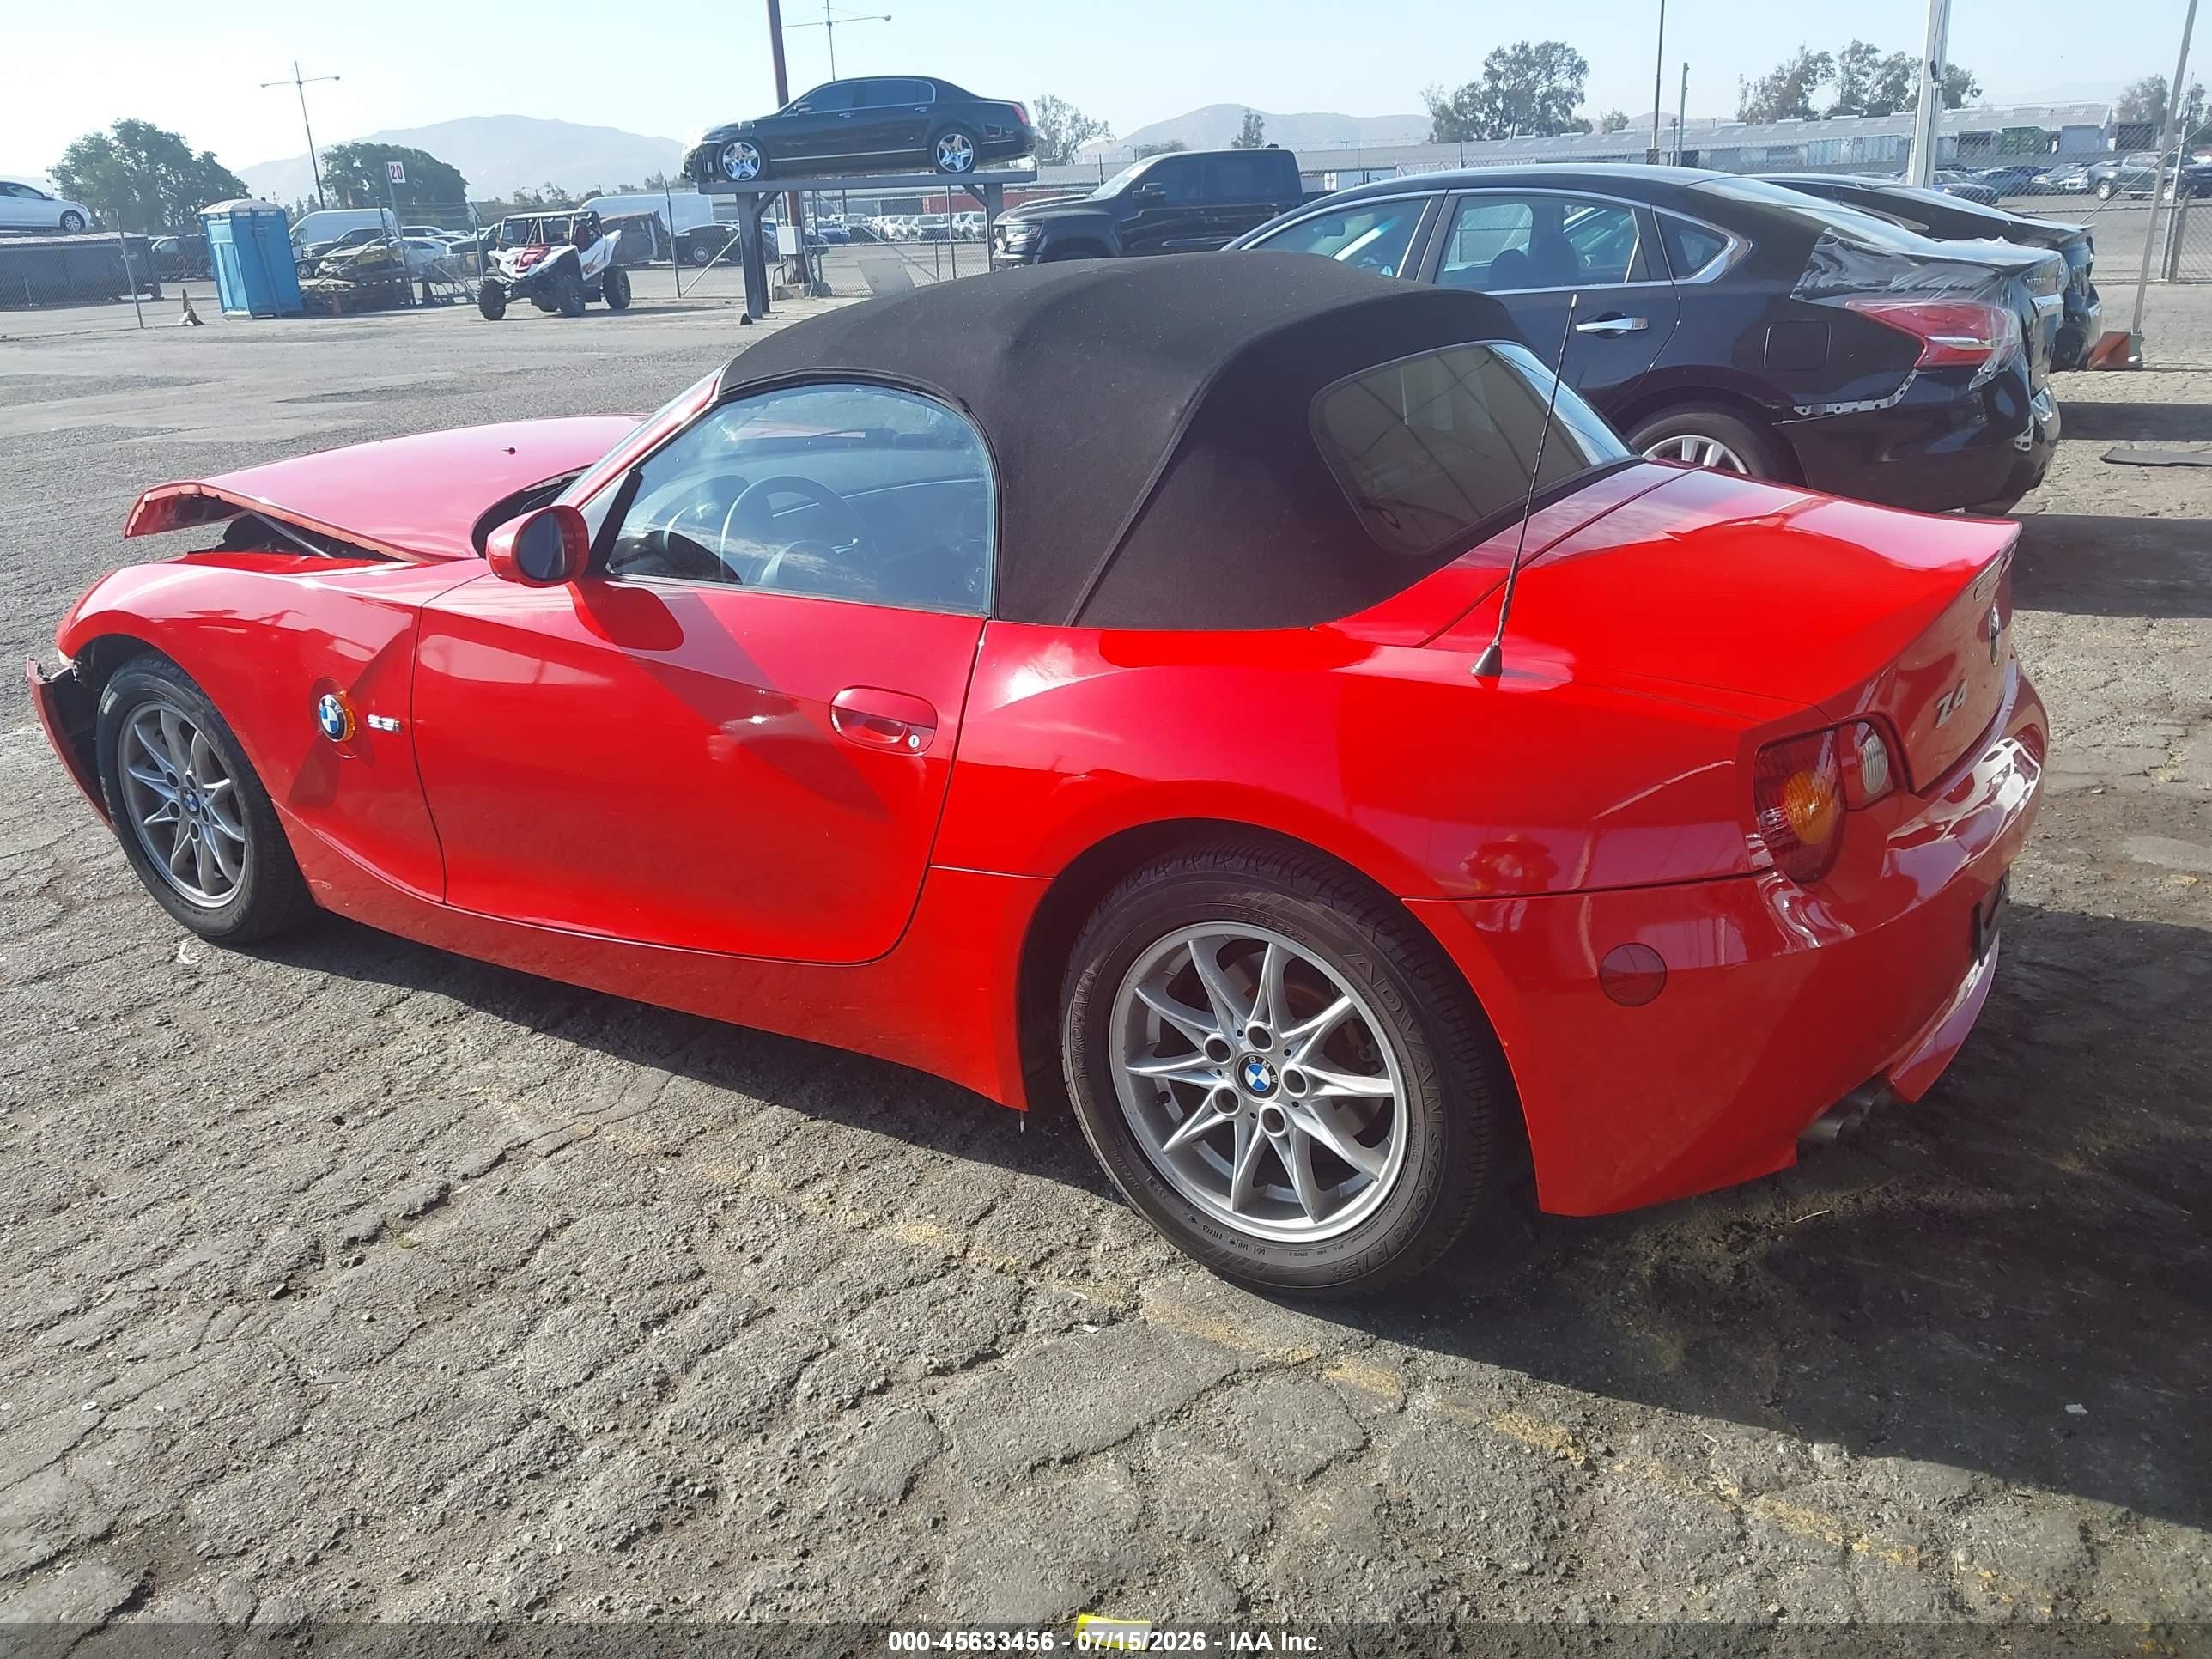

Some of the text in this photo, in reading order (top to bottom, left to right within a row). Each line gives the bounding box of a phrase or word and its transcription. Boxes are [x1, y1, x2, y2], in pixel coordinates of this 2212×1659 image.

[390, 164, 403, 179] 20
[1936, 678, 1968, 729] Z4
[1072, 967, 1100, 1079] YOKOHAMA
[1342, 952, 1444, 1124] ADVAN
[1249, 1056, 1279, 1084] BMW
